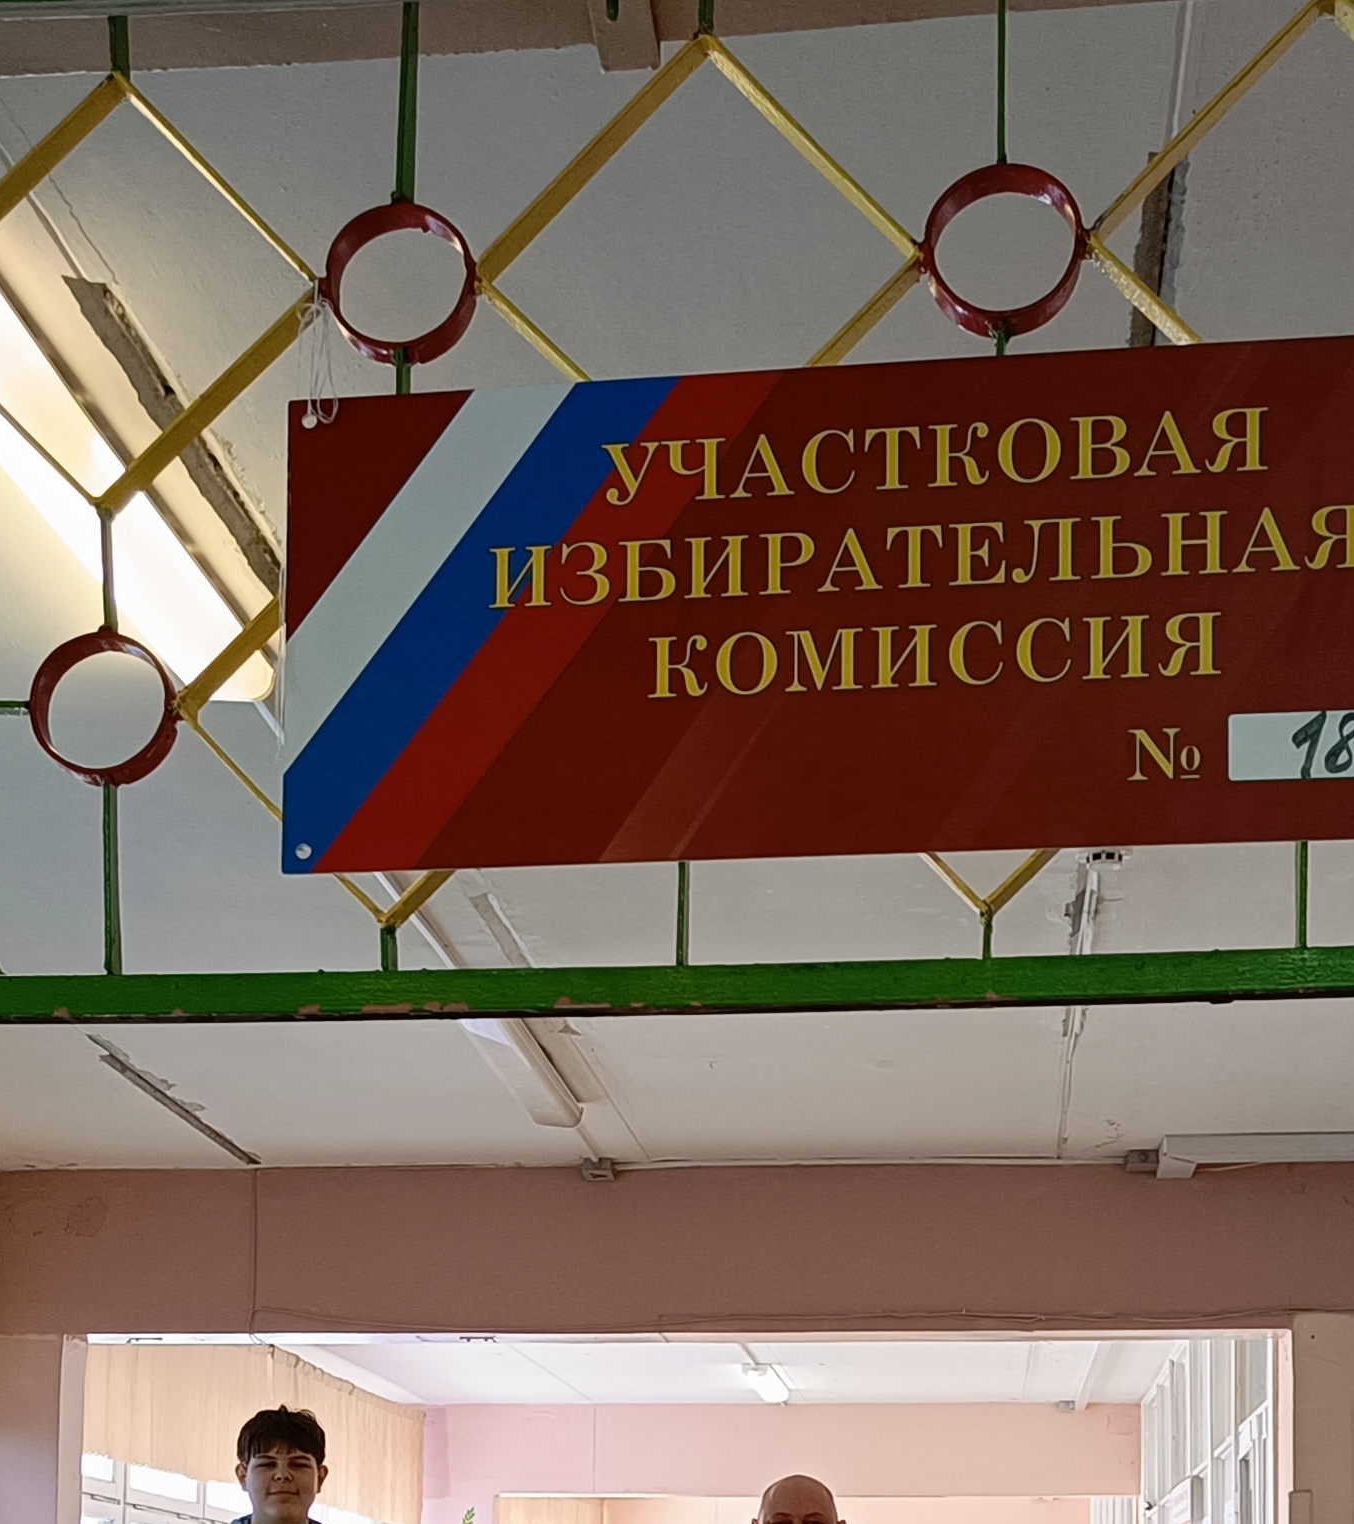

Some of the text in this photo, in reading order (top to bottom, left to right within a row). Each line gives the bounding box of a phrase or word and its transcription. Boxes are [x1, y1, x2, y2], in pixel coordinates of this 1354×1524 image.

[601, 406, 1269, 506] УЧАСТКОВАЯ
[648, 611, 1222, 698] КОМИССИЯ
[1127, 727, 1201, 780] №
